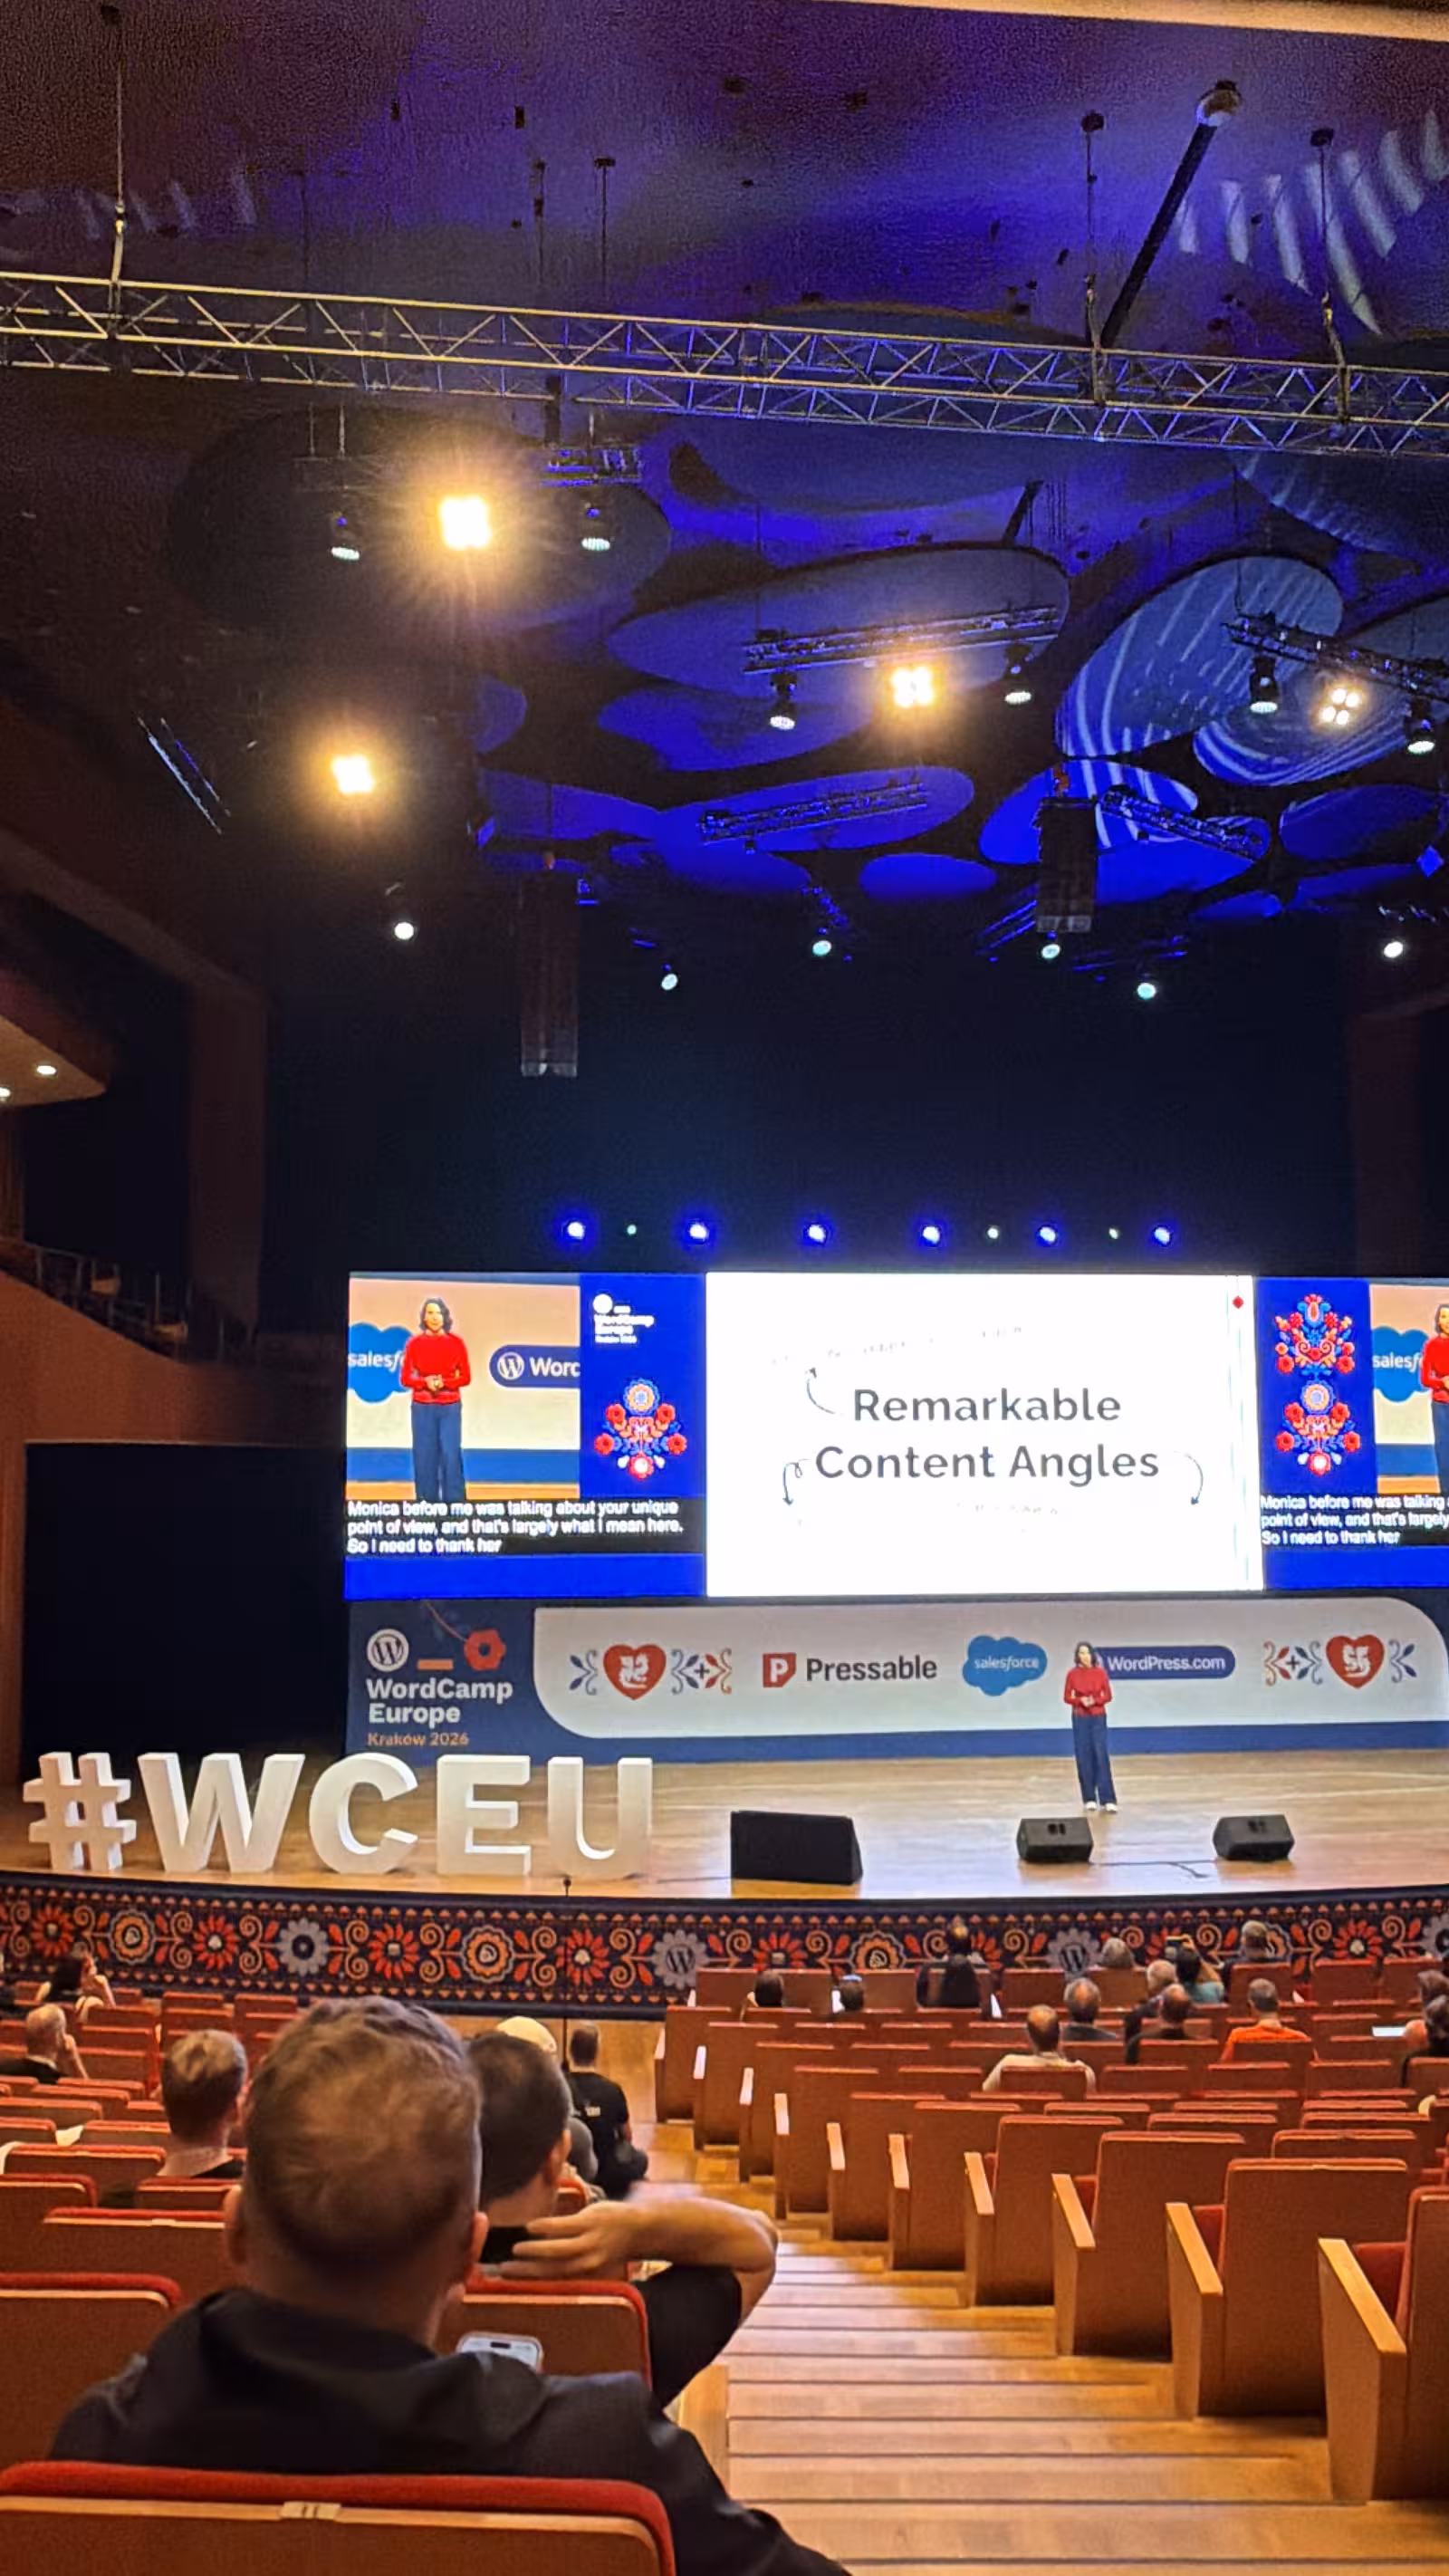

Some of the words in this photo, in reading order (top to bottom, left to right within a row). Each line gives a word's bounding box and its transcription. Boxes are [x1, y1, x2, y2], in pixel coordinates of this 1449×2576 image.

[348, 1350, 405, 1373] salesf
[1373, 1351, 1423, 1373] salesf
[854, 1388, 1120, 1421] Remarkable
[816, 1446, 994, 1478] Content
[1009, 1444, 1158, 1487] Angles
[348, 1500, 399, 1516] Monica
[403, 1500, 447, 1515] before
[450, 1503, 473, 1515] me
[475, 1503, 504, 1515] was
[507, 1500, 552, 1517] talking
[556, 1500, 595, 1514] about
[598, 1502, 629, 1517] your
[632, 1499, 678, 1517] unique
[1261, 1495, 1306, 1509] Monica
[1309, 1495, 1349, 1509] before
[1375, 1496, 1402, 1508] was
[1404, 1495, 1444, 1510] talking
[347, 1520, 383, 1535] point
[386, 1519, 401, 1534] of
[403, 1520, 438, 1535] view,
[441, 1519, 468, 1533] and
[472, 1519, 509, 1534] that's
[512, 1518, 559, 1536] largely
[561, 1518, 595, 1533] what
[606, 1520, 645, 1533] mean
[648, 1518, 684, 1533] here.
[1261, 1514, 1292, 1528] point
[1295, 1513, 1309, 1527] of
[1345, 1514, 1370, 1526] and
[347, 1538, 369, 1552] So
[379, 1538, 416, 1552] need
[417, 1538, 433, 1552] to
[435, 1537, 475, 1552] thank
[476, 1538, 503, 1552] her
[1262, 1531, 1281, 1545] So
[1290, 1531, 1322, 1544] need
[1325, 1530, 1339, 1544] to
[1341, 1530, 1377, 1544] thank
[806, 1654, 937, 1681] Pressable
[974, 1655, 1039, 1672] salesforce
[1108, 1655, 1225, 1671] WordPress.com
[366, 1677, 513, 1704] WordCamp
[369, 1703, 461, 1729] Europe
[368, 1732, 426, 1746] Kraków
[429, 1732, 469, 1745] 2026
[23, 1751, 654, 1879] #WCEU
